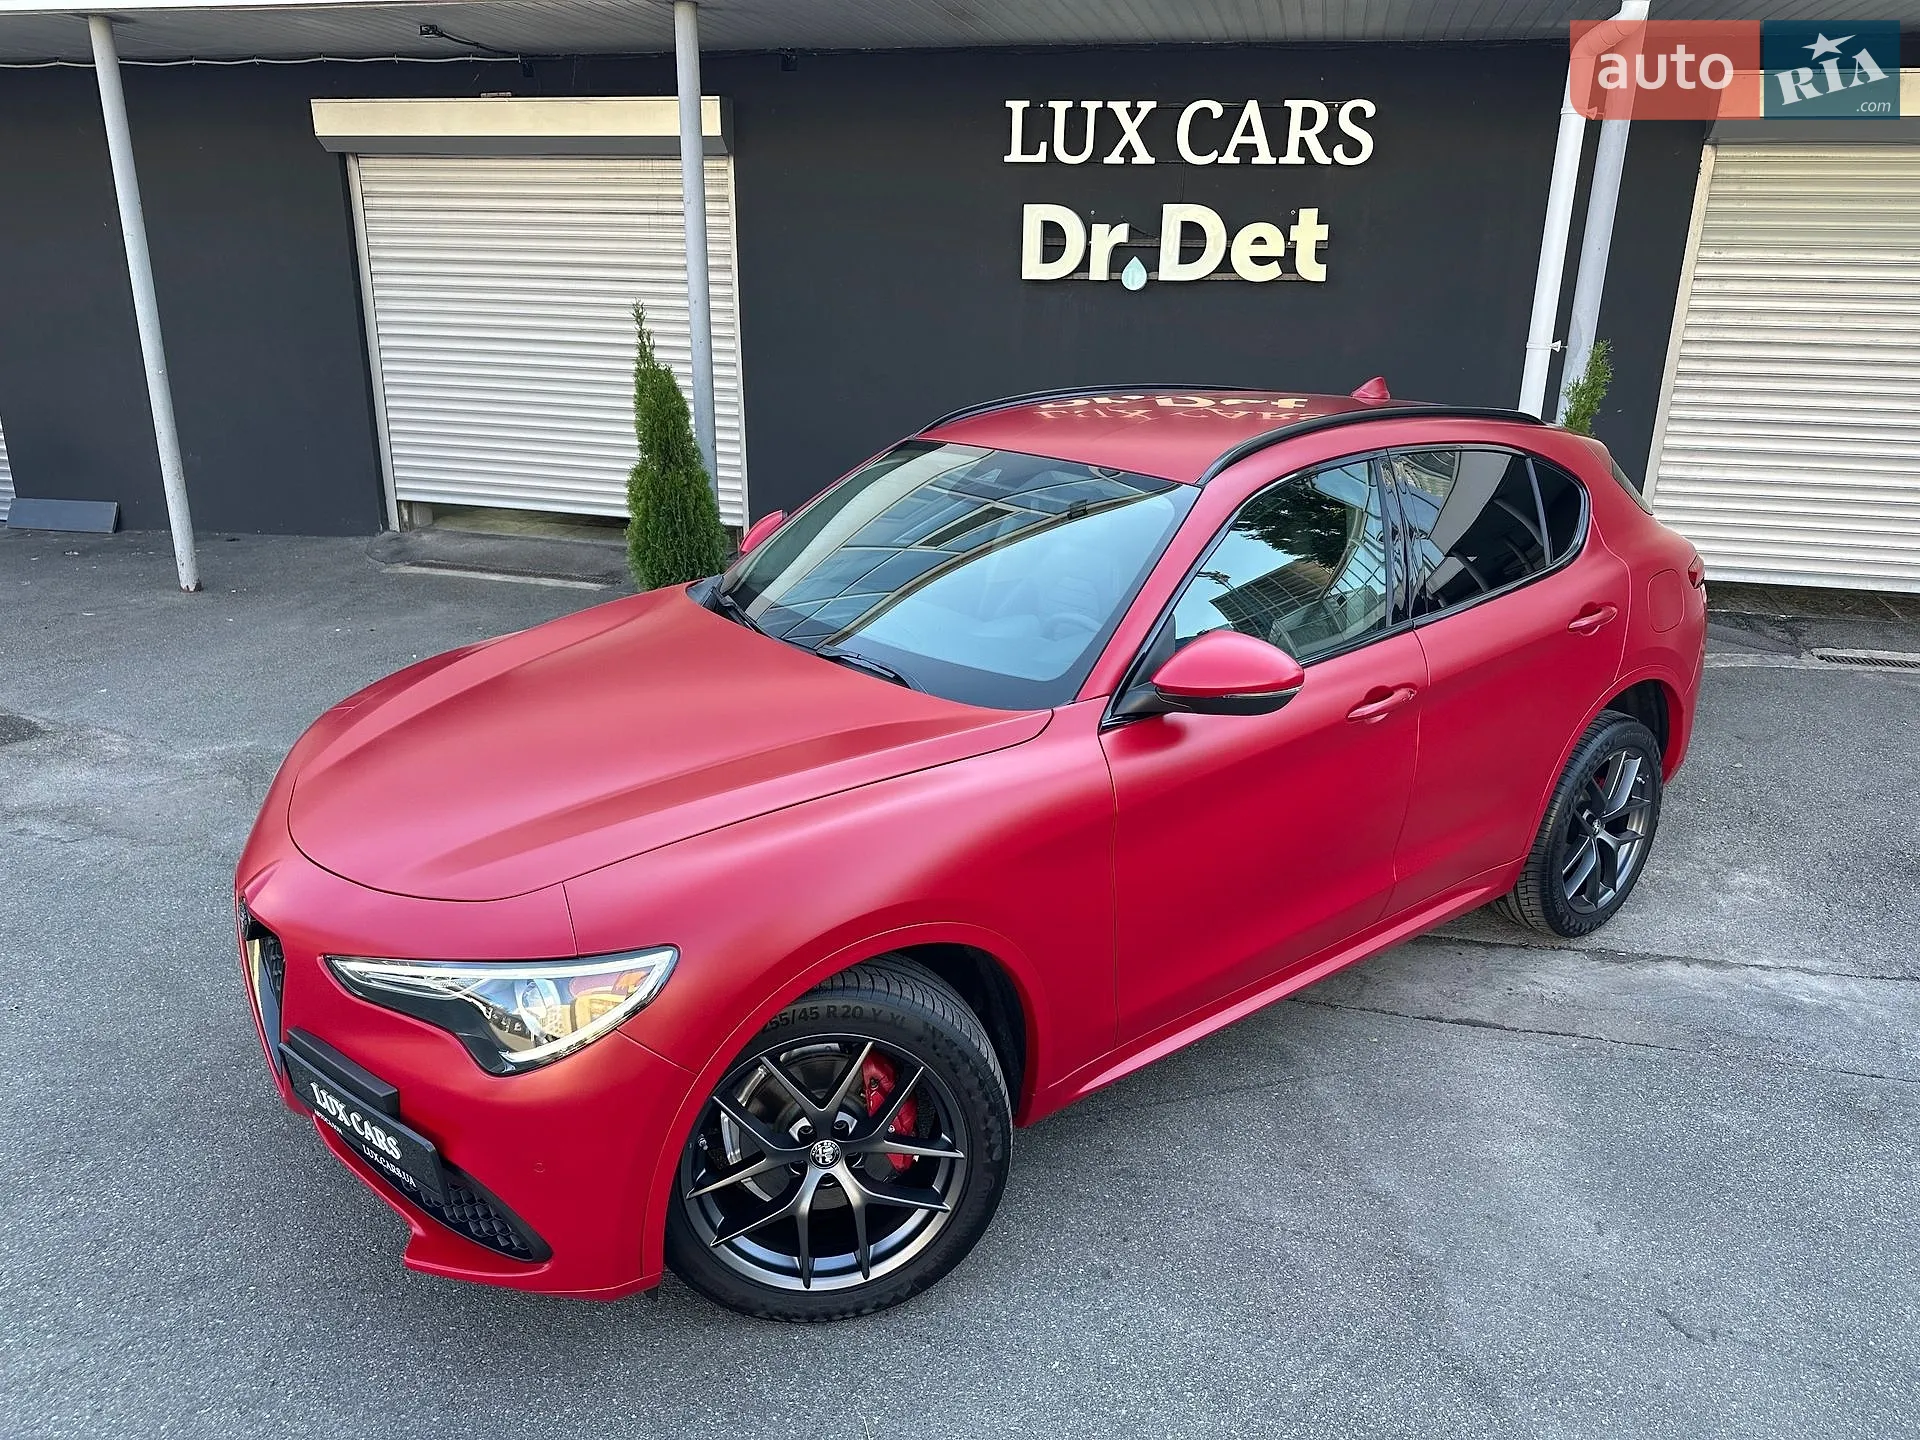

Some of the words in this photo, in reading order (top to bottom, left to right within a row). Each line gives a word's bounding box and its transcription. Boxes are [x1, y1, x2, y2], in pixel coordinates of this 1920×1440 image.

[1003, 99, 1158, 165] LUX
[1175, 98, 1377, 166] CARS
[310, 1081, 352, 1127] LUX
[350, 1112, 403, 1160] CARS
